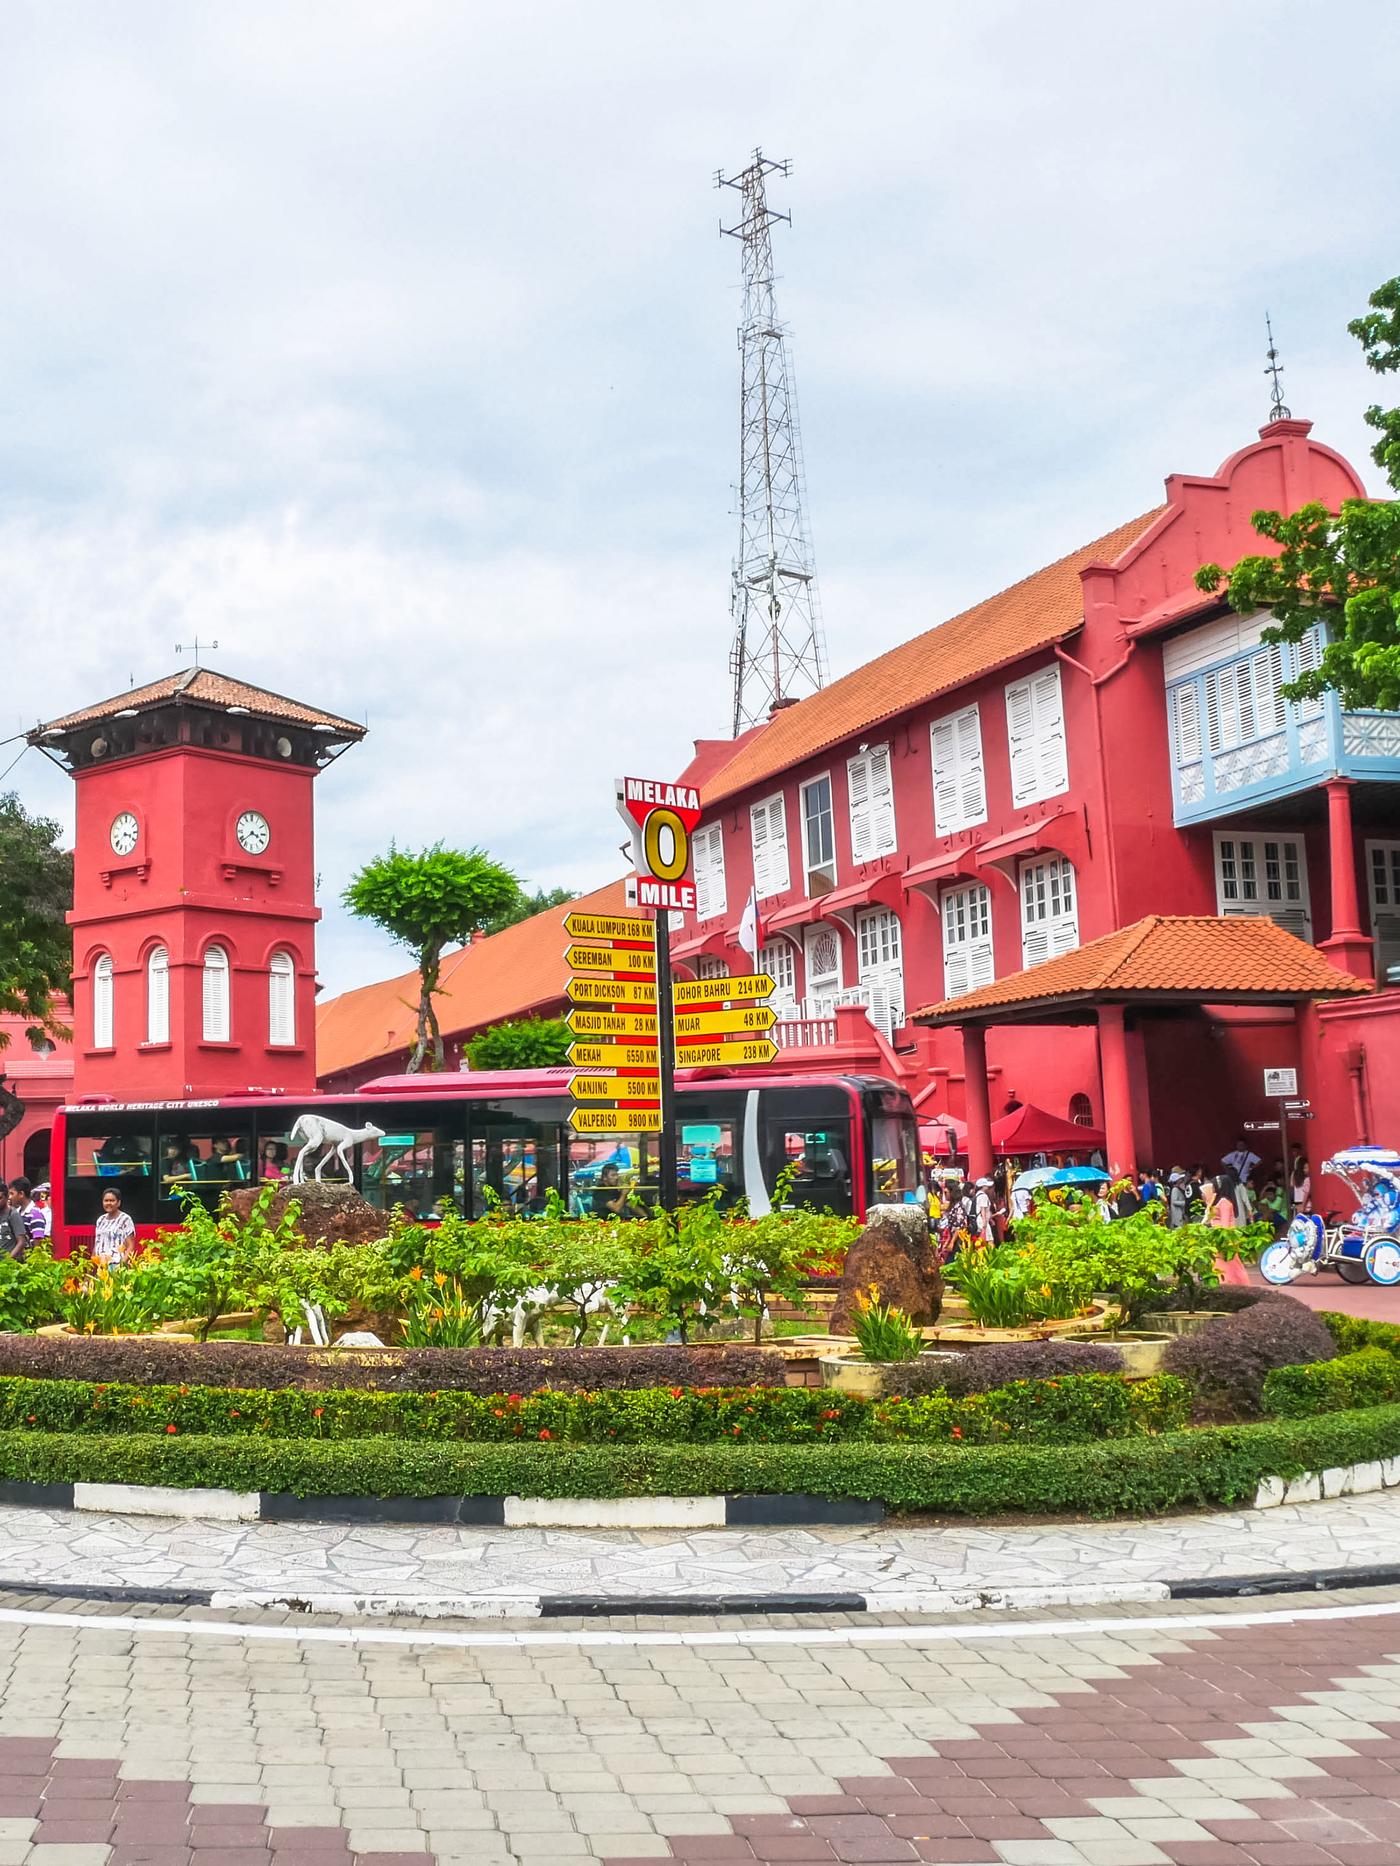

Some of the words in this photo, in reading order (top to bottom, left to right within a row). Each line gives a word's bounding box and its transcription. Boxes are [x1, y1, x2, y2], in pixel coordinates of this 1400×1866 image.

[628, 780, 699, 810] MELAKA
[641, 884, 694, 908] MILE
[572, 919, 595, 933] KUALA
[596, 921, 626, 935] LUMPUR
[628, 924, 640, 936] 168
[642, 925, 652, 937] KM
[574, 951, 612, 966] SEREMBAN
[628, 956, 641, 967] 100
[643, 956, 653, 968] KM
[574, 983, 592, 997] PORT
[594, 986, 625, 998] DICKSON
[633, 988, 642, 999] 87
[644, 988, 654, 1000] KM
[677, 985, 702, 1000] JOHOR
[704, 983, 730, 996] BAHRU
[738, 981, 752, 994] 214
[756, 980, 768, 993] KM
[576, 1016, 601, 1030] MASJID
[604, 1017, 625, 1030] TANAH
[634, 1019, 644, 1031] 28
[645, 1020, 656, 1031] KM
[678, 1018, 700, 1031] MUAR
[744, 1013, 754, 1026] 48
[756, 1012, 769, 1025] KM
[576, 1049, 601, 1061] MEKAH
[626, 1050, 644, 1062] 6550
[646, 1051, 657, 1063] KM
[679, 1048, 720, 1063] SINGAPORE
[744, 1046, 756, 1059] 238
[759, 1045, 770, 1057] KM
[577, 1082, 608, 1094] NANJING
[628, 1082, 646, 1094] 5500
[648, 1083, 658, 1095] KM
[578, 1114, 617, 1127] VALPERISO
[628, 1114, 647, 1126] 9800
[648, 1114, 659, 1127] KM
